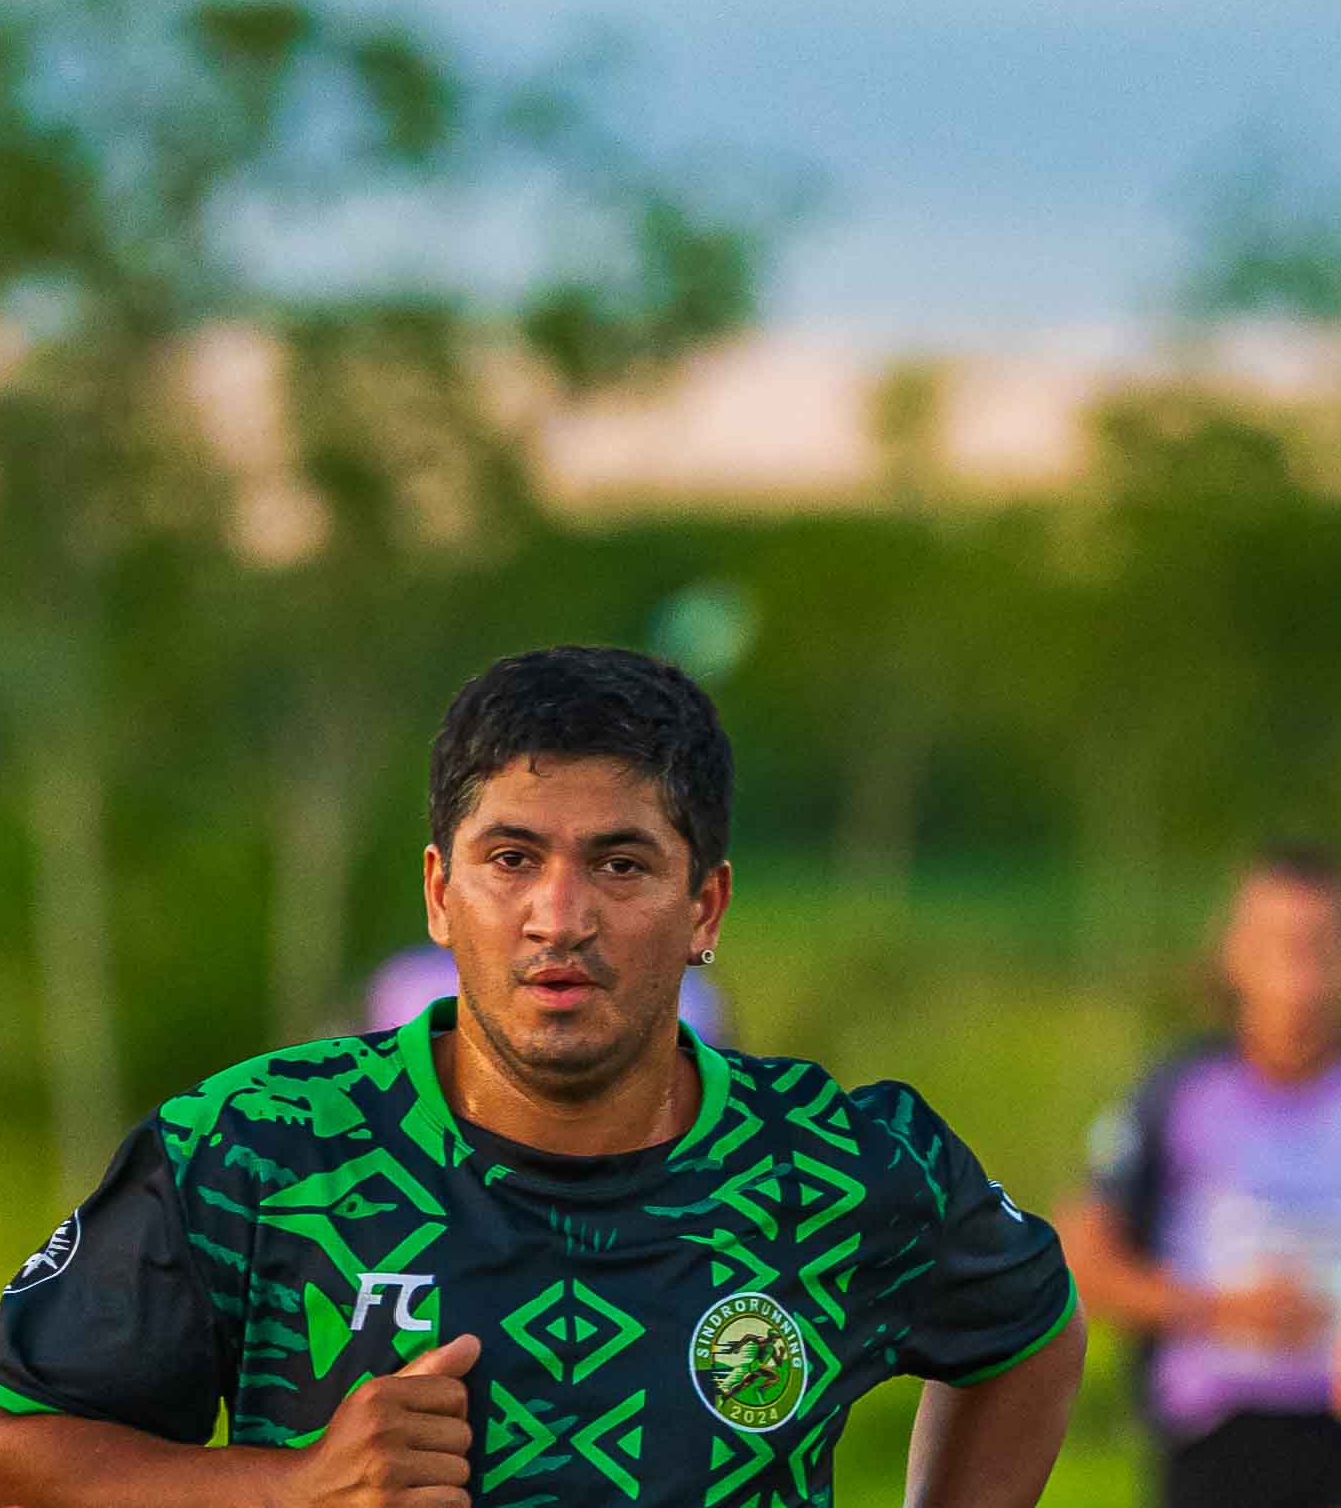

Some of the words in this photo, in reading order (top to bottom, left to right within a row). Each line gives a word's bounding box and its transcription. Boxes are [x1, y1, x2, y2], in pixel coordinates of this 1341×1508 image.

[350, 1273, 436, 1331] FC
[696, 1298, 802, 1369] SINDRORUNNING
[730, 1405, 778, 1424] 2024
